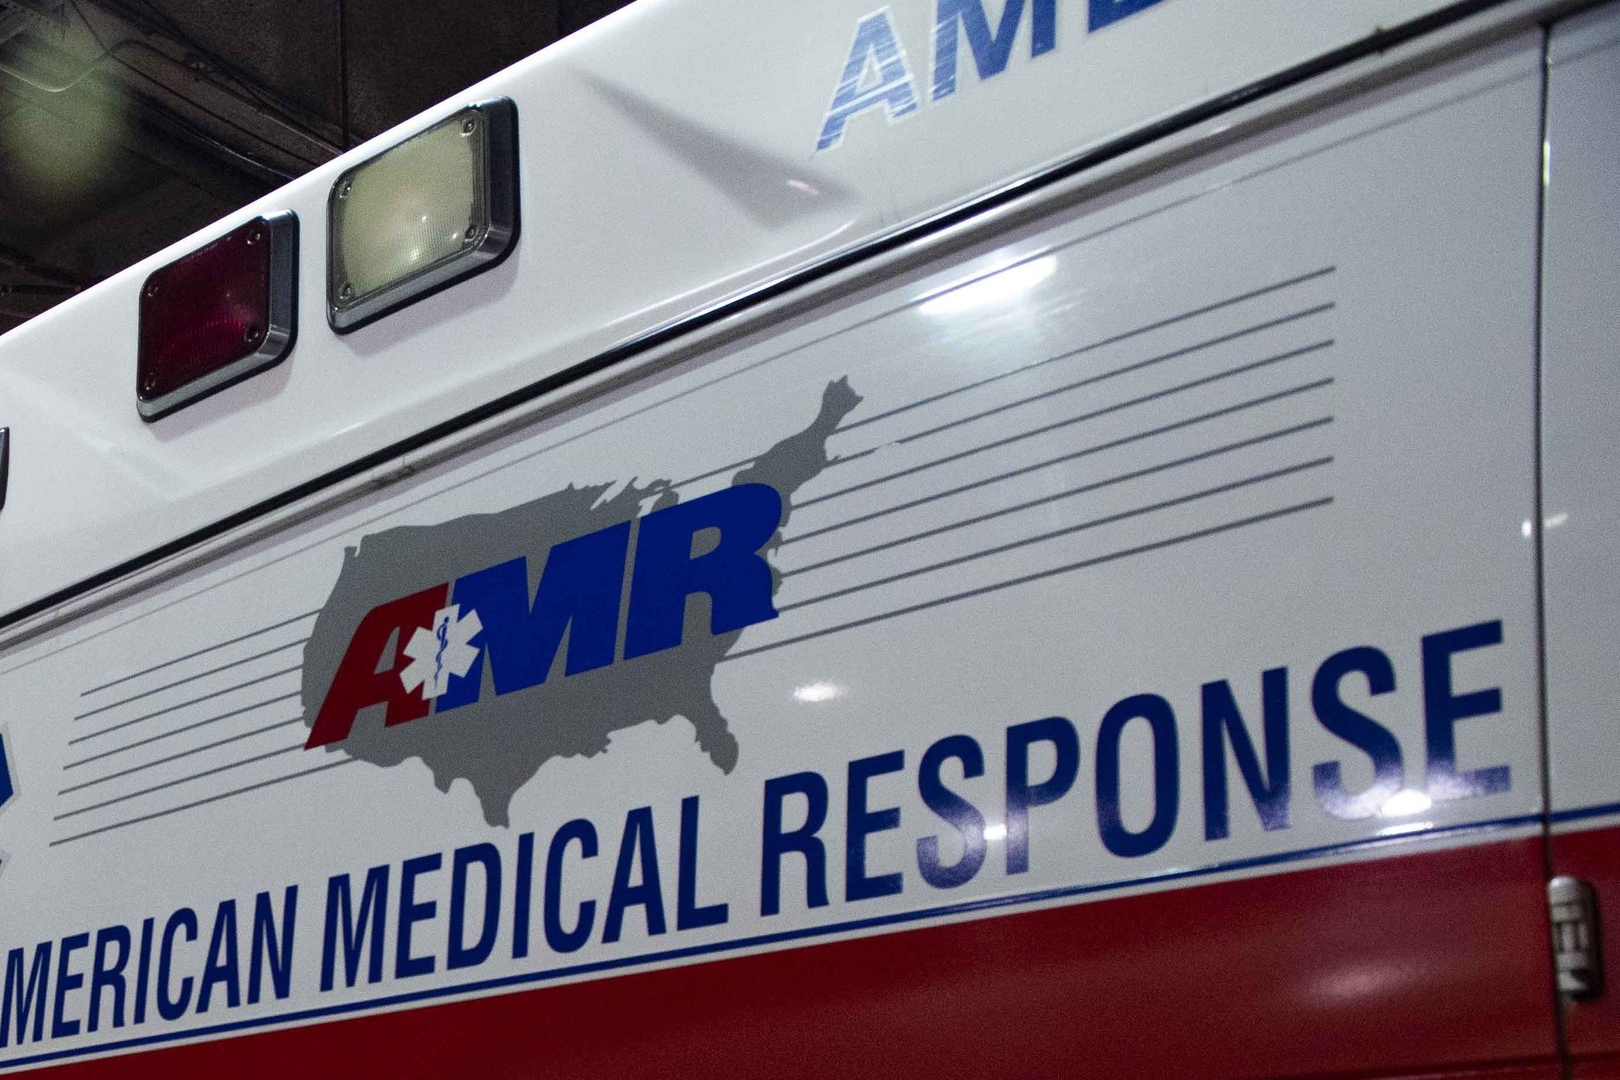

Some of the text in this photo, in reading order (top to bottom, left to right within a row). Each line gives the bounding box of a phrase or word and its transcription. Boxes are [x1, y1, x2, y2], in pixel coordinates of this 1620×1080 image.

[305, 481, 785, 750] AMR
[319, 795, 730, 993] MEDICAL
[760, 620, 1512, 917] RESPONSE
